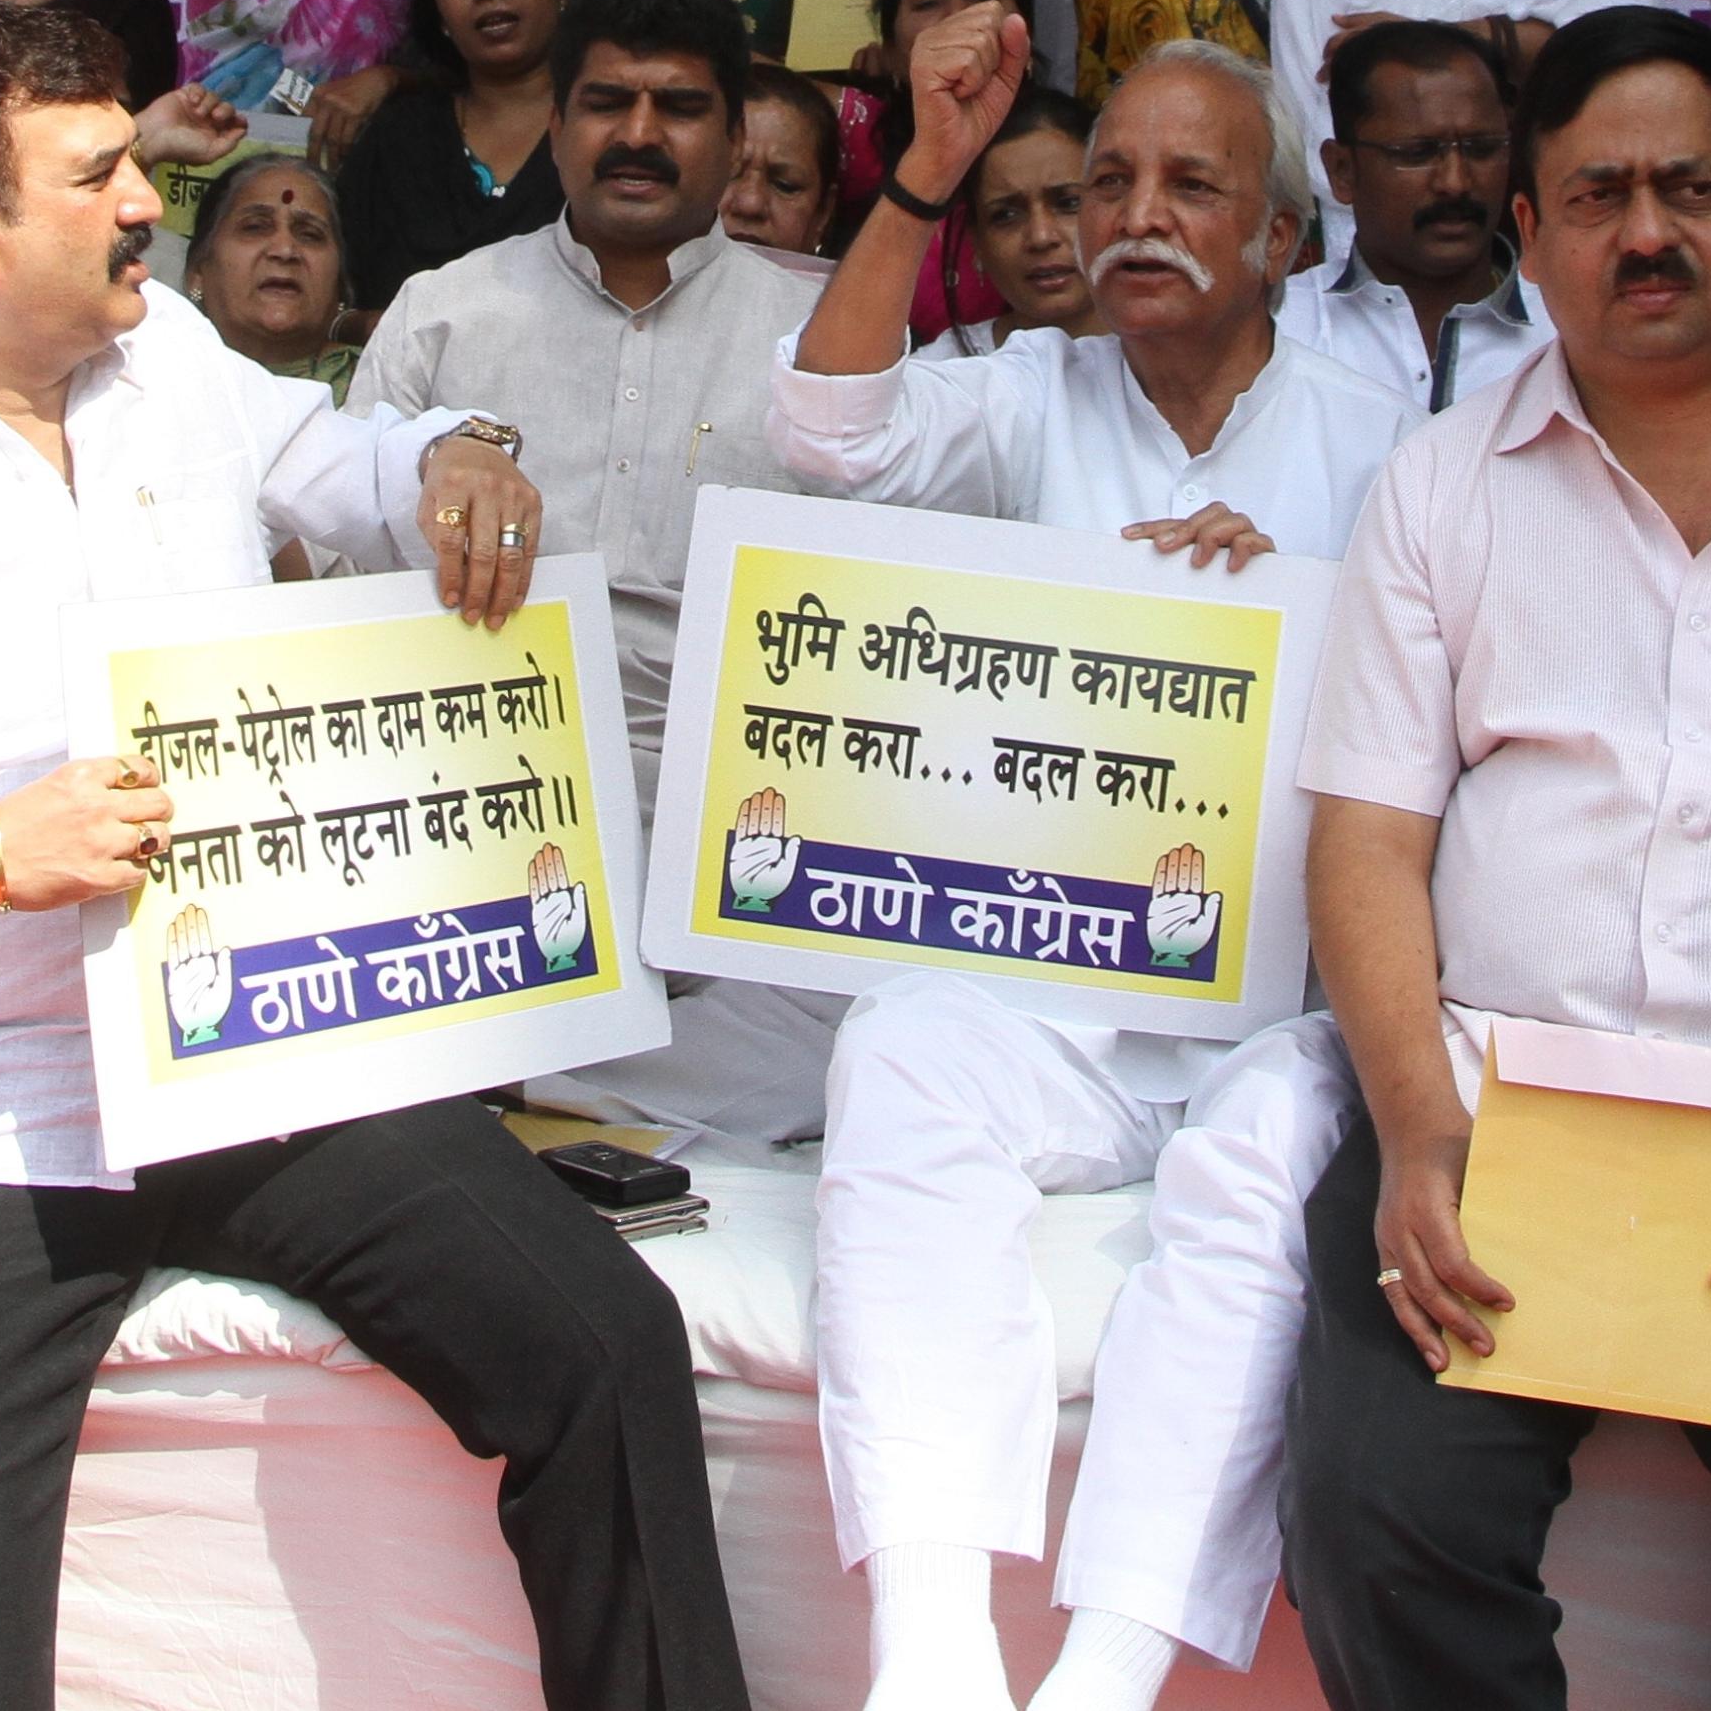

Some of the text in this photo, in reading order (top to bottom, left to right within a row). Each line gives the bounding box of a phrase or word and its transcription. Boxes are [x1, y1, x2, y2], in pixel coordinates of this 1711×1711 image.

[756, 592, 1257, 724] भुमि अधिग्रहण कायद्यात
[321, 699, 367, 756] का
[372, 691, 425, 760] दाम
[429, 683, 489, 745] कम
[742, 704, 835, 771] बदल
[992, 736, 1086, 805] बदल
[250, 790, 307, 877] को
[314, 799, 413, 888] लूटना
[417, 771, 474, 853] बंद
[805, 857, 935, 941] ठाणे
[241, 936, 360, 1035] ठाणे
